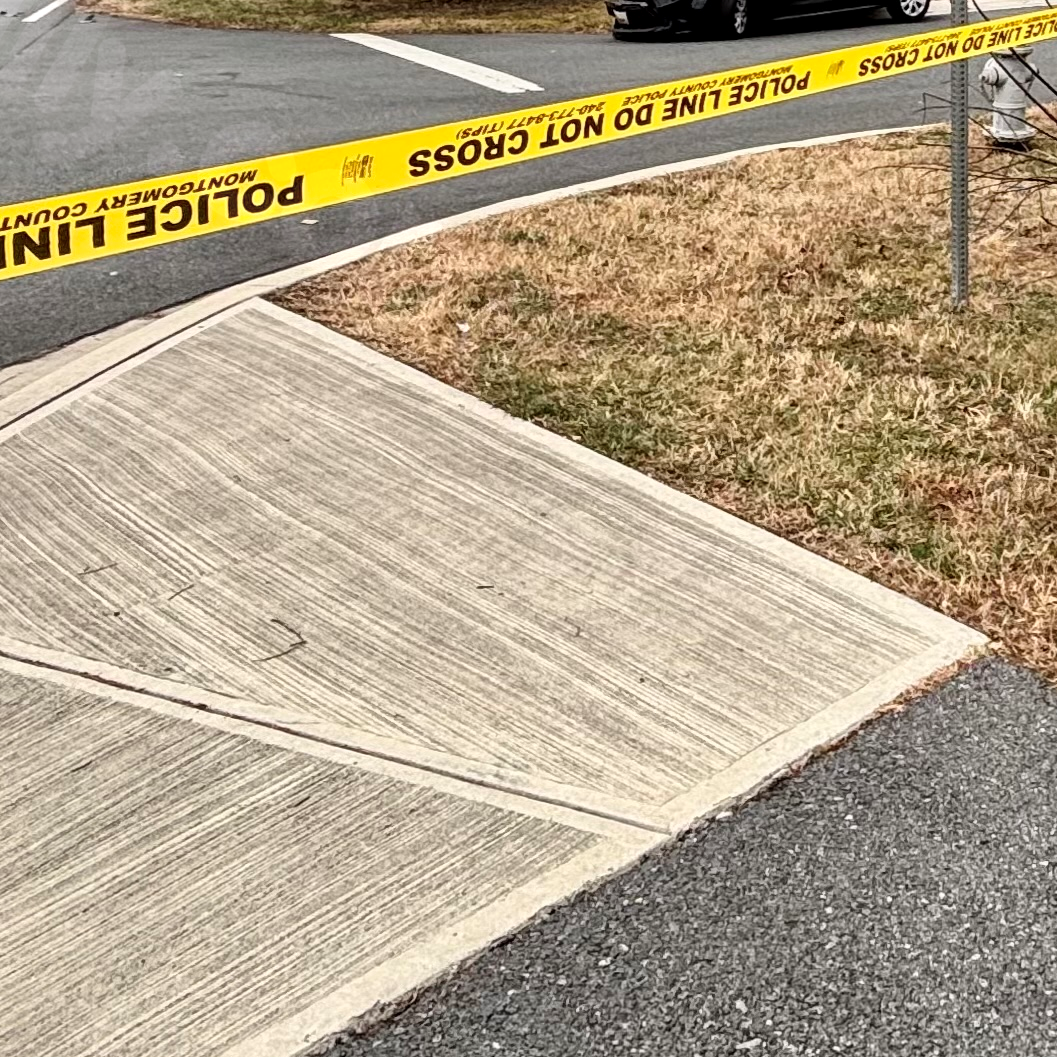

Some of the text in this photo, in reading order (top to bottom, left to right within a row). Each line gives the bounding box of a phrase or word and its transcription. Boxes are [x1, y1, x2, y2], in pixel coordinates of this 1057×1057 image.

[922, 39, 958, 62] NOT
[962, 34, 985, 52] DO
[987, 27, 1022, 48] LINE
[858, 49, 920, 77] CROSS
[455, 65, 793, 141] MONTGOMERY COUNTY POLICE 240-773-8477 (TIPS)
[662, 89, 722, 122] LINE
[729, 71, 811, 106] POLICE
[540, 113, 605, 149] NOT
[614, 103, 654, 131] DO
[408, 130, 528, 177] CROSS
[94, 170, 257, 213] MONTGOMERY
[125, 175, 303, 240] POLICE
